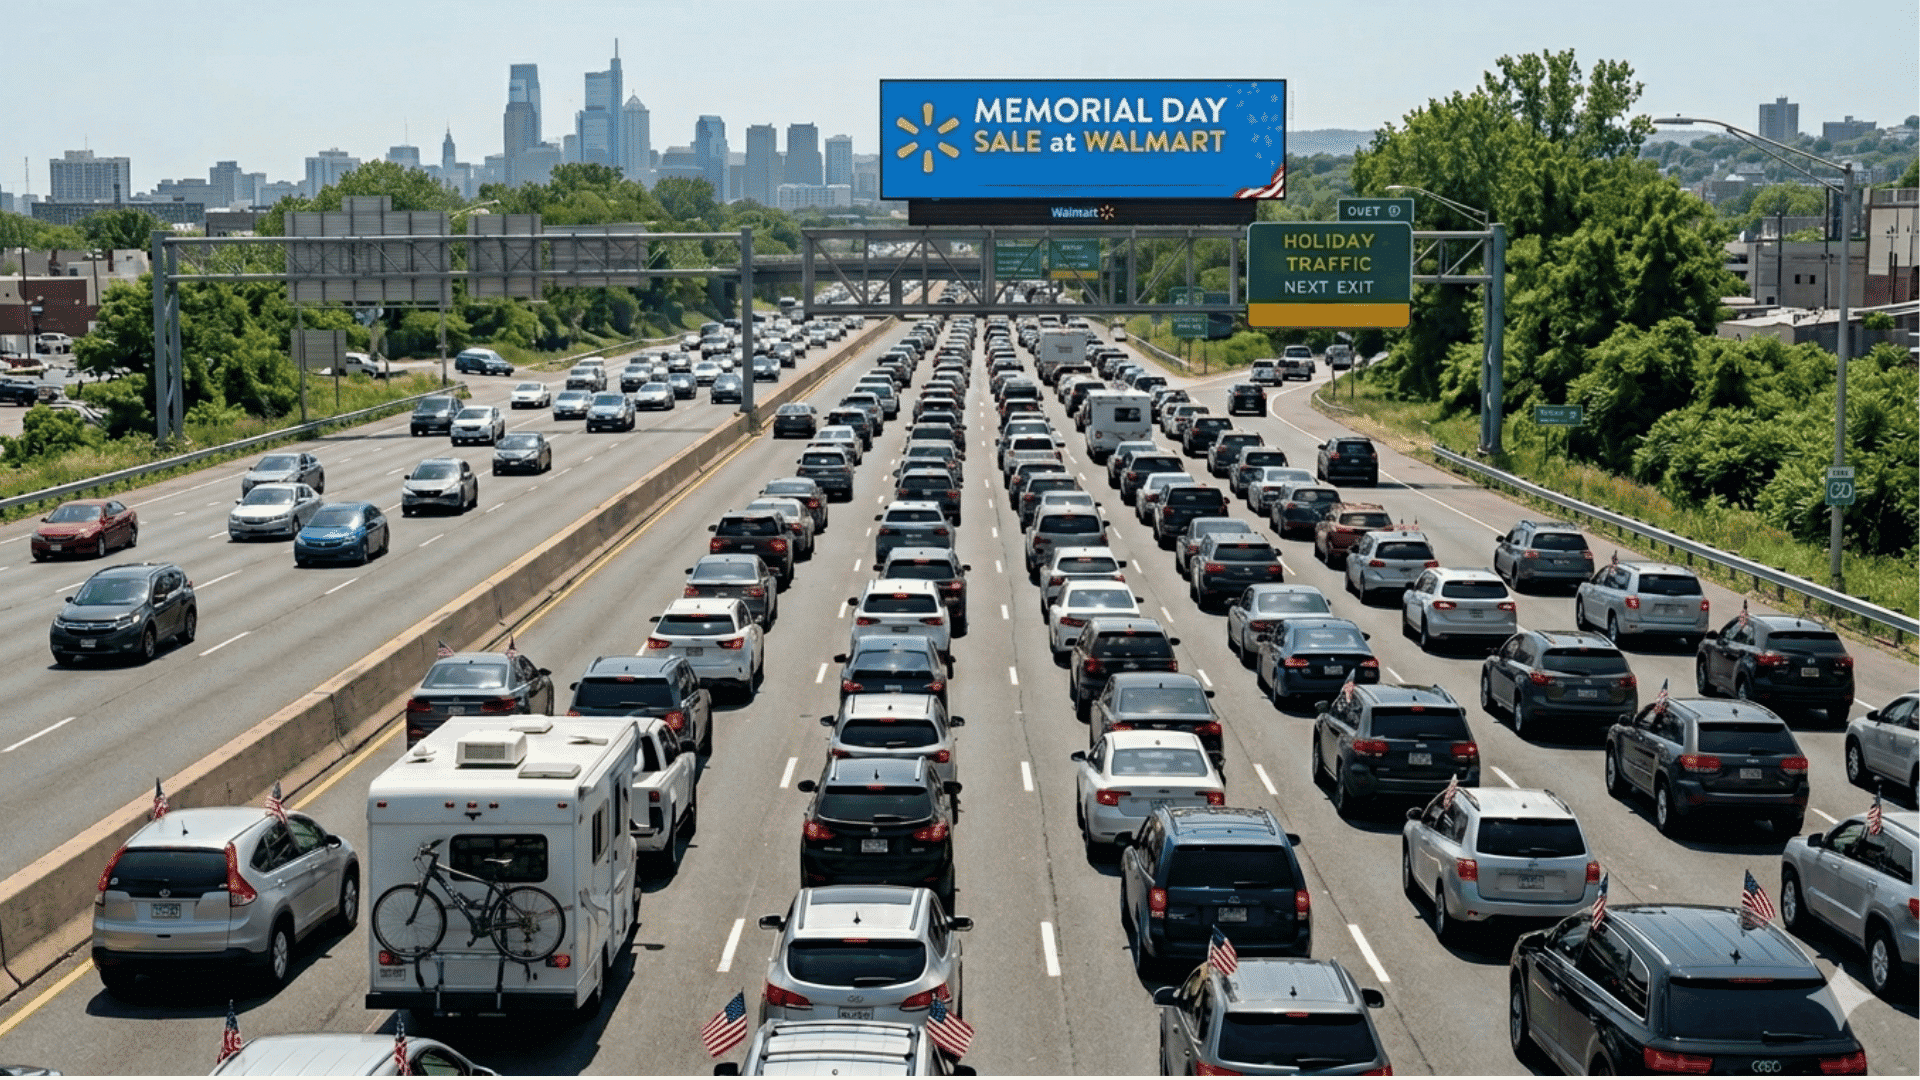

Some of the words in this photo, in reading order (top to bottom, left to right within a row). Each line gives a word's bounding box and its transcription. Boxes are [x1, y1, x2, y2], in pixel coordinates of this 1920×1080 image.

[974, 97, 1153, 124] MEMORIAL
[1162, 97, 1228, 124] DAY
[974, 130, 1042, 153] SALE
[1050, 132, 1076, 153] at
[1083, 130, 1226, 153] WALMART
[1051, 207, 1099, 218] Walmart
[1284, 233, 1375, 249] HOLIDAY
[1286, 257, 1372, 272] TRAFFIC
[1284, 280, 1329, 294] NEXT
[1337, 280, 1374, 294] EXIT
